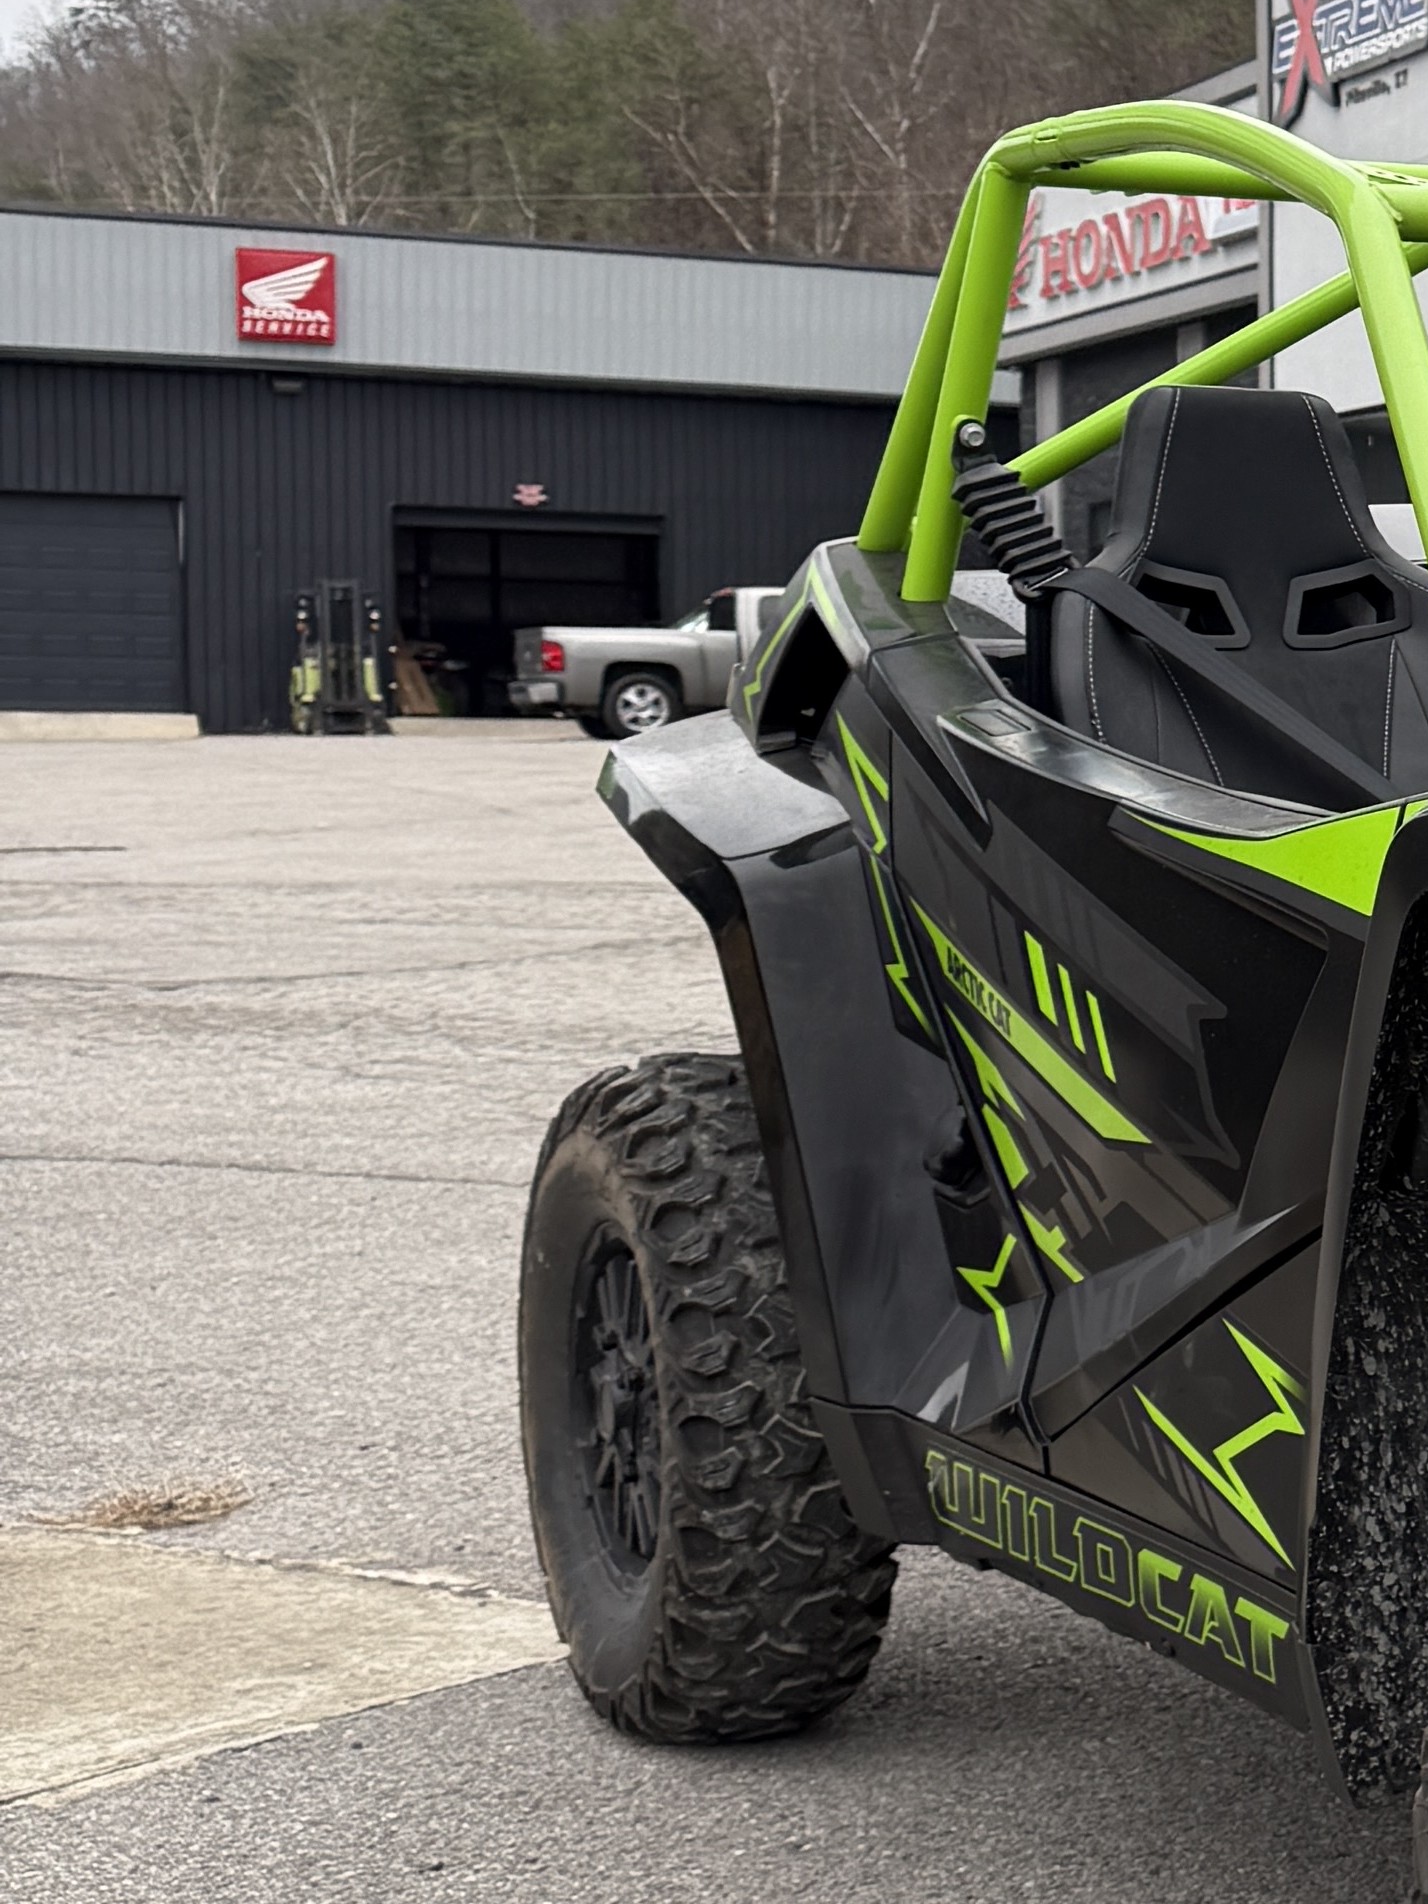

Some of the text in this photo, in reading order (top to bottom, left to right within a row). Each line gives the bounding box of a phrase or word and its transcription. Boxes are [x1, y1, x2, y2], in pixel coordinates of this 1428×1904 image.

[1039, 196, 1212, 300] HONDA
[242, 306, 329, 323] HONDA
[242, 320, 329, 337] SERVICE
[946, 945, 1011, 1038] ARCTIC CAT
[925, 1450, 1290, 1684] WILDCAT
